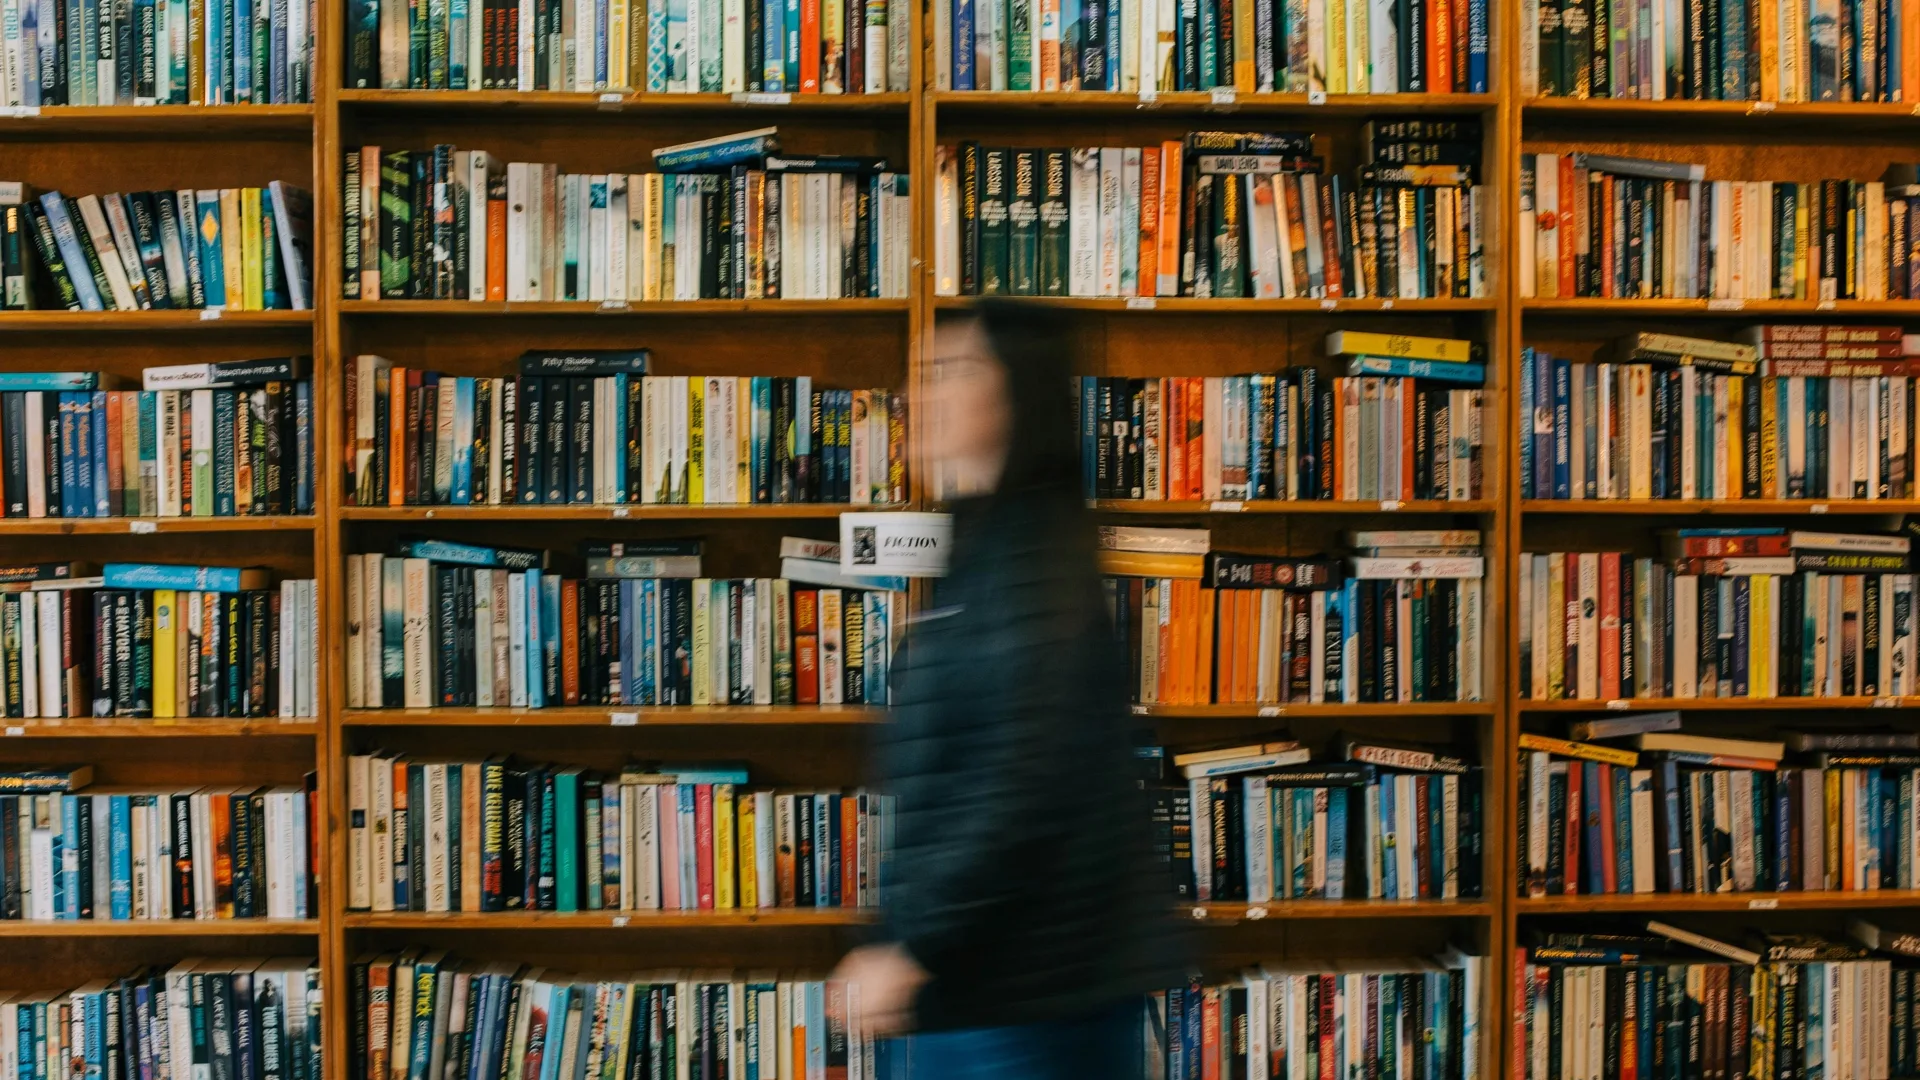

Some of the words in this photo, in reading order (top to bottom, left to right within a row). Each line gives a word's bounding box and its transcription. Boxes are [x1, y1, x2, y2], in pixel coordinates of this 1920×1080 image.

[143, 6, 154, 35] CROSS
[632, 5, 642, 67] Abomination
[101, 26, 111, 57] SWAP
[143, 57, 154, 83] HEART
[988, 152, 1001, 196] LARSSON
[1019, 153, 1031, 196] LARSSON
[1048, 153, 1061, 197] LARSSON
[346, 173, 359, 216] HILLERMAN
[133, 201, 151, 243] GIMENEZ
[346, 226, 359, 253] TALKING
[346, 255, 359, 269] GOD
[147, 267, 160, 302] LAWYER
[504, 381, 515, 412] STAR
[1086, 387, 1095, 436] sightseeing
[238, 403, 249, 446] REGINALD
[504, 421, 514, 460] NORTH
[884, 536, 938, 548] FICTION
[116, 615, 130, 661] HAYDER
[443, 593, 454, 646] HOARDER
[846, 607, 863, 667] KELLERMAN
[1326, 631, 1339, 674] EXILE
[118, 662, 128, 702] BIRDMAN
[487, 765, 501, 790] FAYE
[234, 800, 245, 826] MATT
[487, 792, 501, 852] KELLERMAN
[541, 793, 553, 832] ANGEL
[1214, 800, 1226, 859] MONUMENT
[236, 829, 248, 868] HILTON
[541, 837, 554, 873] TAPES
[262, 1007, 278, 1027] TWO
[262, 1028, 278, 1071] SOLDIERS
